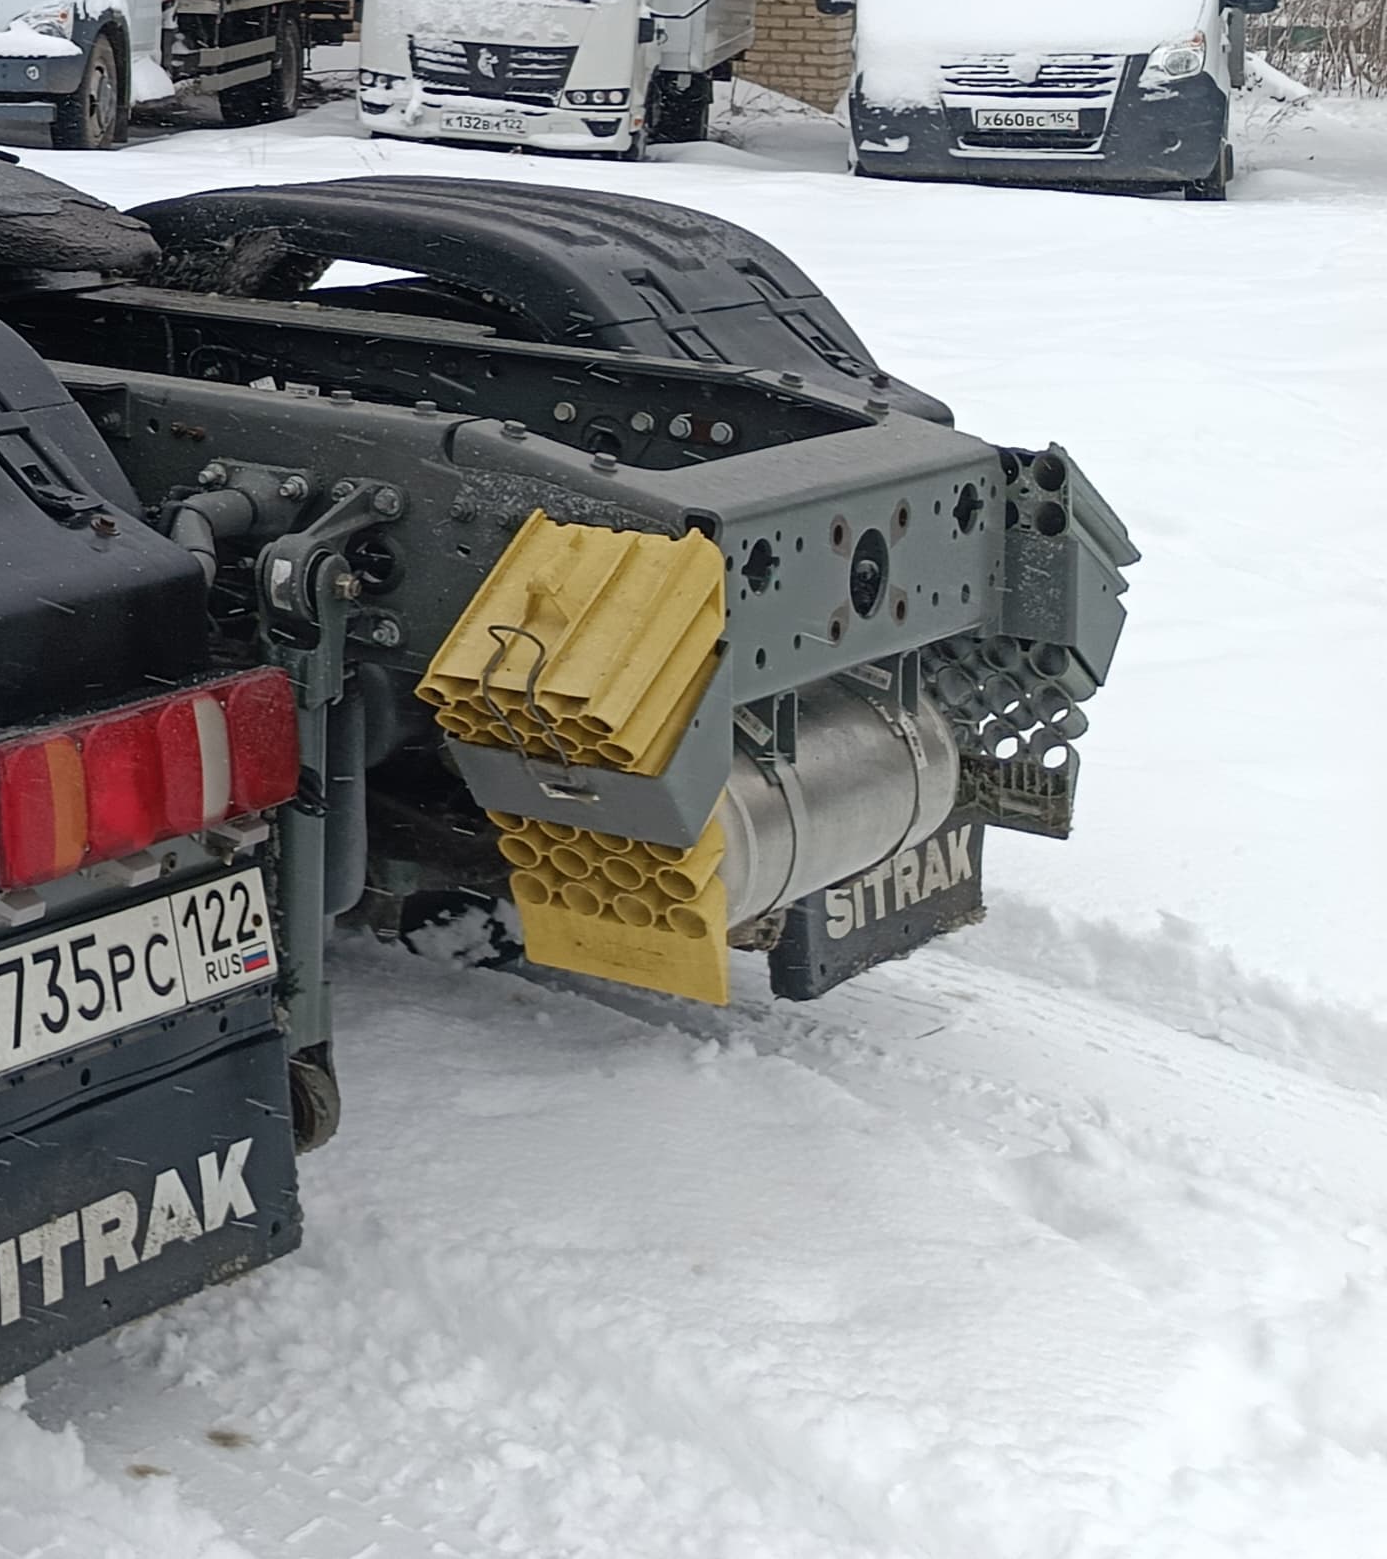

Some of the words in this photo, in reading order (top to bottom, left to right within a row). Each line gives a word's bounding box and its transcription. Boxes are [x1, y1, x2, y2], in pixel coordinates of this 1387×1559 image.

[502, 118, 524, 130] 122
[983, 112, 1045, 127] Х660ВС
[1050, 112, 1074, 124] 154
[825, 824, 972, 940] SITRAK
[182, 881, 256, 957] 122
[205, 953, 242, 986] RUS
